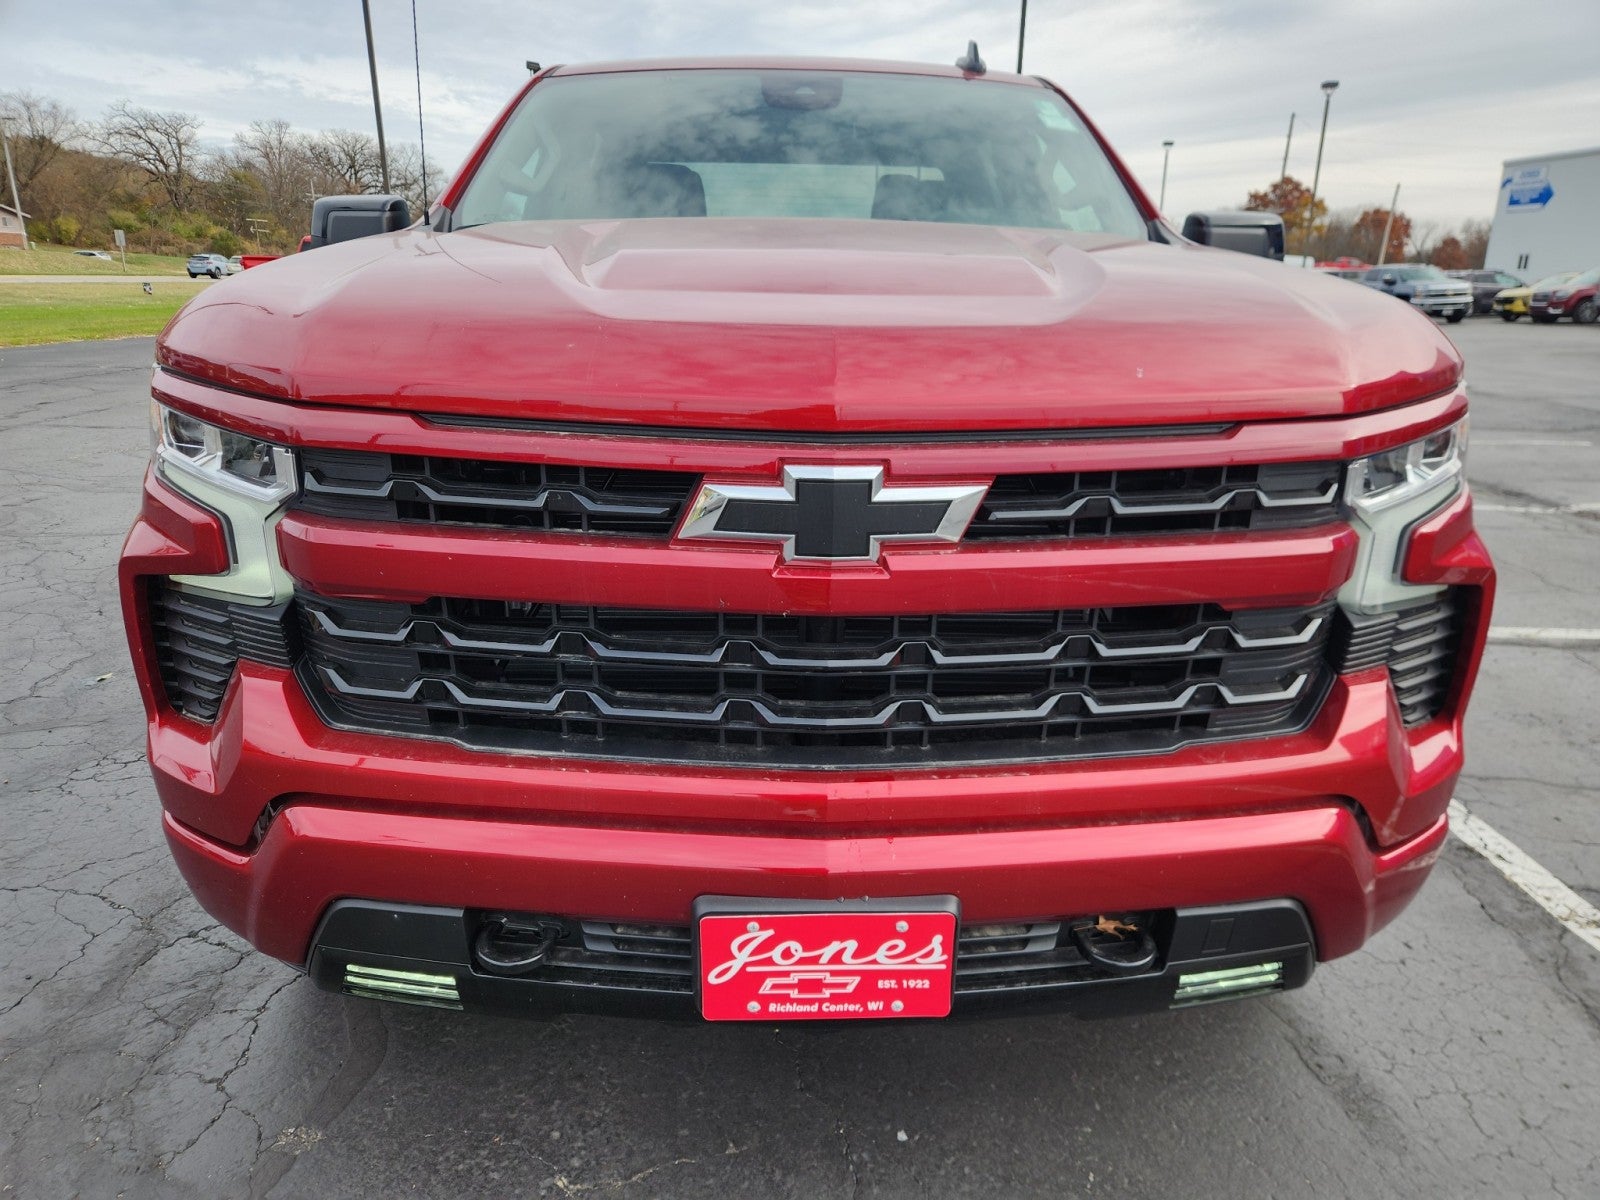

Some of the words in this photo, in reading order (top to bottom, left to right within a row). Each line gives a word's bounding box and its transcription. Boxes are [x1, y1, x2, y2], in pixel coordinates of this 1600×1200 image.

[707, 929, 948, 985] Jones
[877, 979, 898, 989] EST.
[902, 979, 931, 989] 1922
[768, 1002, 818, 1013] Richland
[821, 1001, 864, 1013] Center,
[867, 1001, 884, 1012] WI
